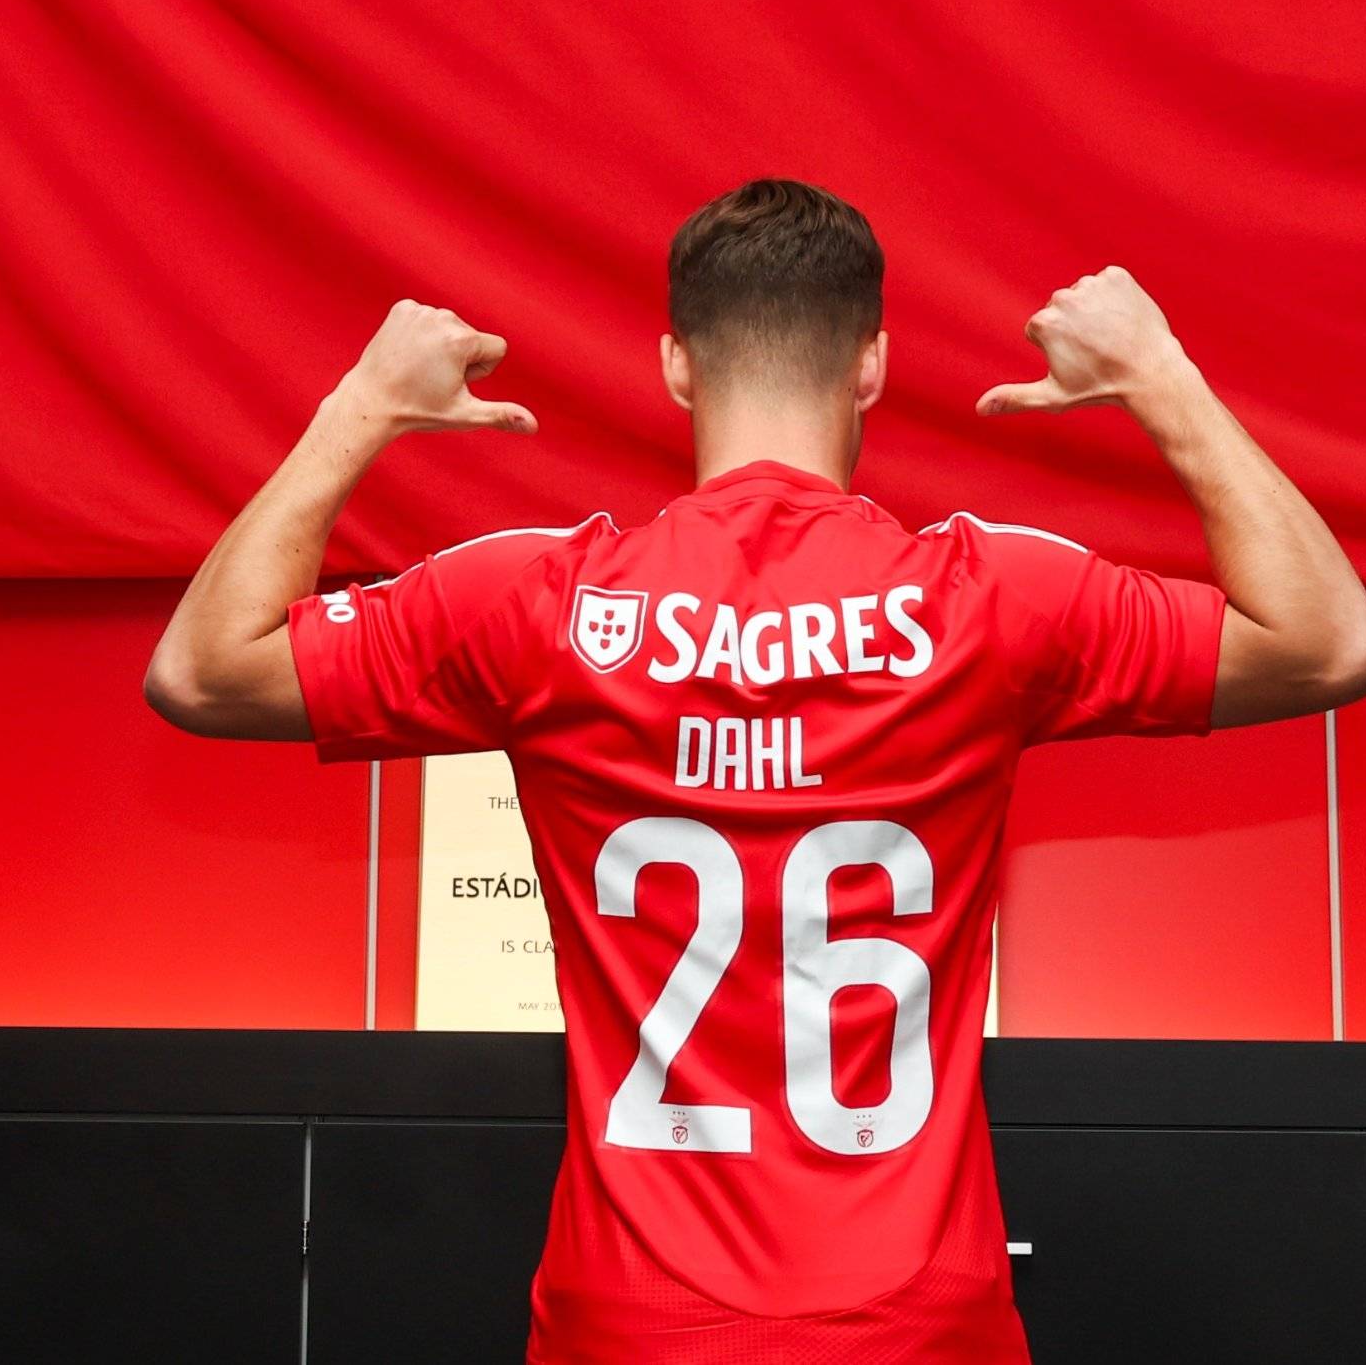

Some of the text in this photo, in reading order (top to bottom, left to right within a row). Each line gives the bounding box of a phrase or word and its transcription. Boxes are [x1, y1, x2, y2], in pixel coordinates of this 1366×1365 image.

[646, 584, 935, 686] SAGRES
[673, 715, 823, 791] DAHL
[487, 796, 518, 810] THE
[501, 939, 515, 954] IS
[517, 1001, 540, 1011] MAY
[593, 816, 935, 1155] 26
